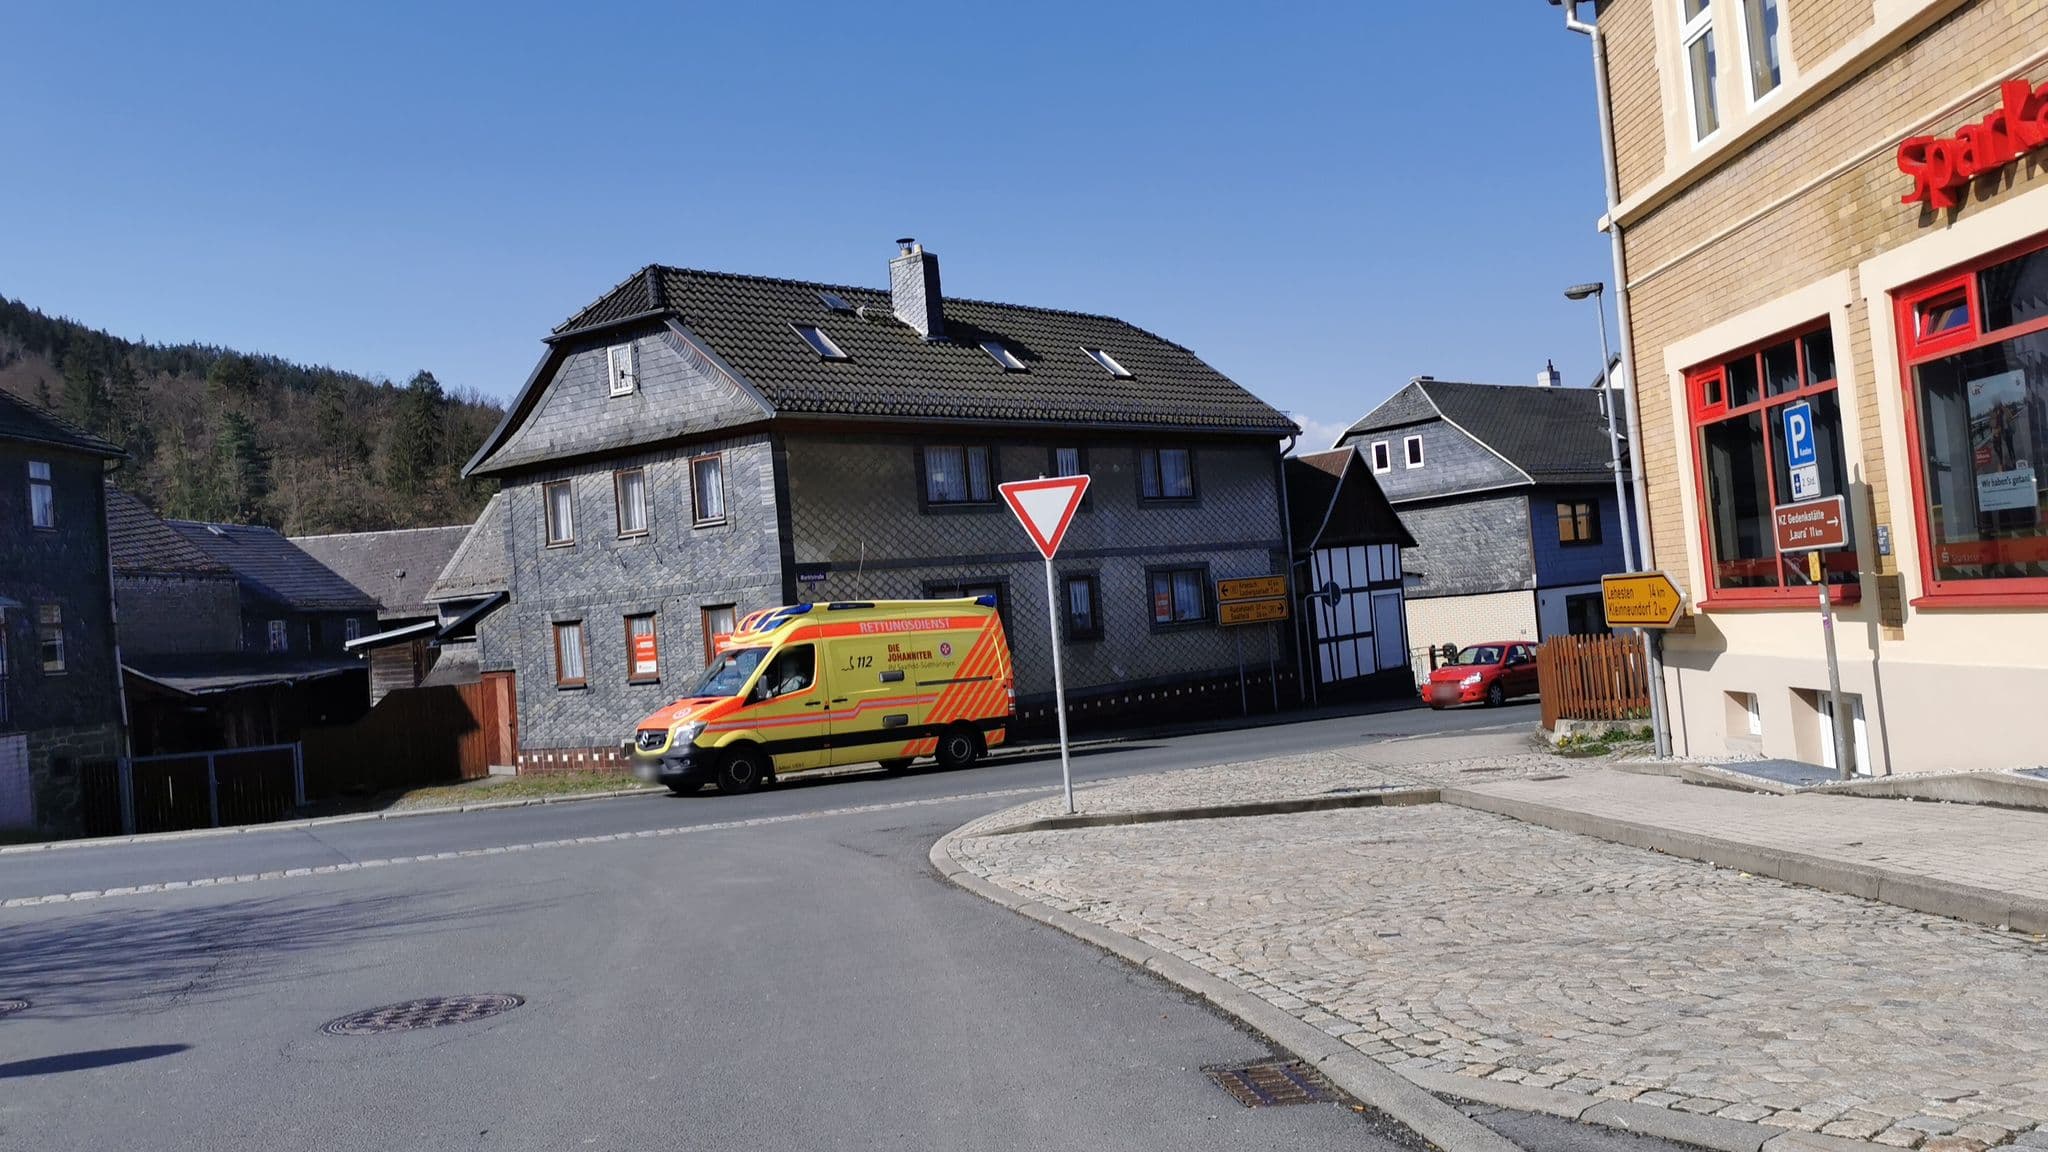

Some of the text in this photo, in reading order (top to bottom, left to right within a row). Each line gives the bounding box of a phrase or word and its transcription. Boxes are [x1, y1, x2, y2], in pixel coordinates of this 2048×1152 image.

[1790, 414, 1806, 459] P
[1981, 480, 1991, 489] Wir
[1991, 476, 2011, 488] haben's
[1778, 509, 1825, 526] KZ Gedenkstätte
[1606, 583, 1666, 600] Lehesten 14 km
[1608, 600, 1668, 617] Kleinneundorf 2 km
[860, 618, 950, 632] RETTUNGSDIENST
[887, 644, 900, 653] DIE
[857, 655, 873, 668] 112
[887, 650, 933, 662] JOHANNITER
